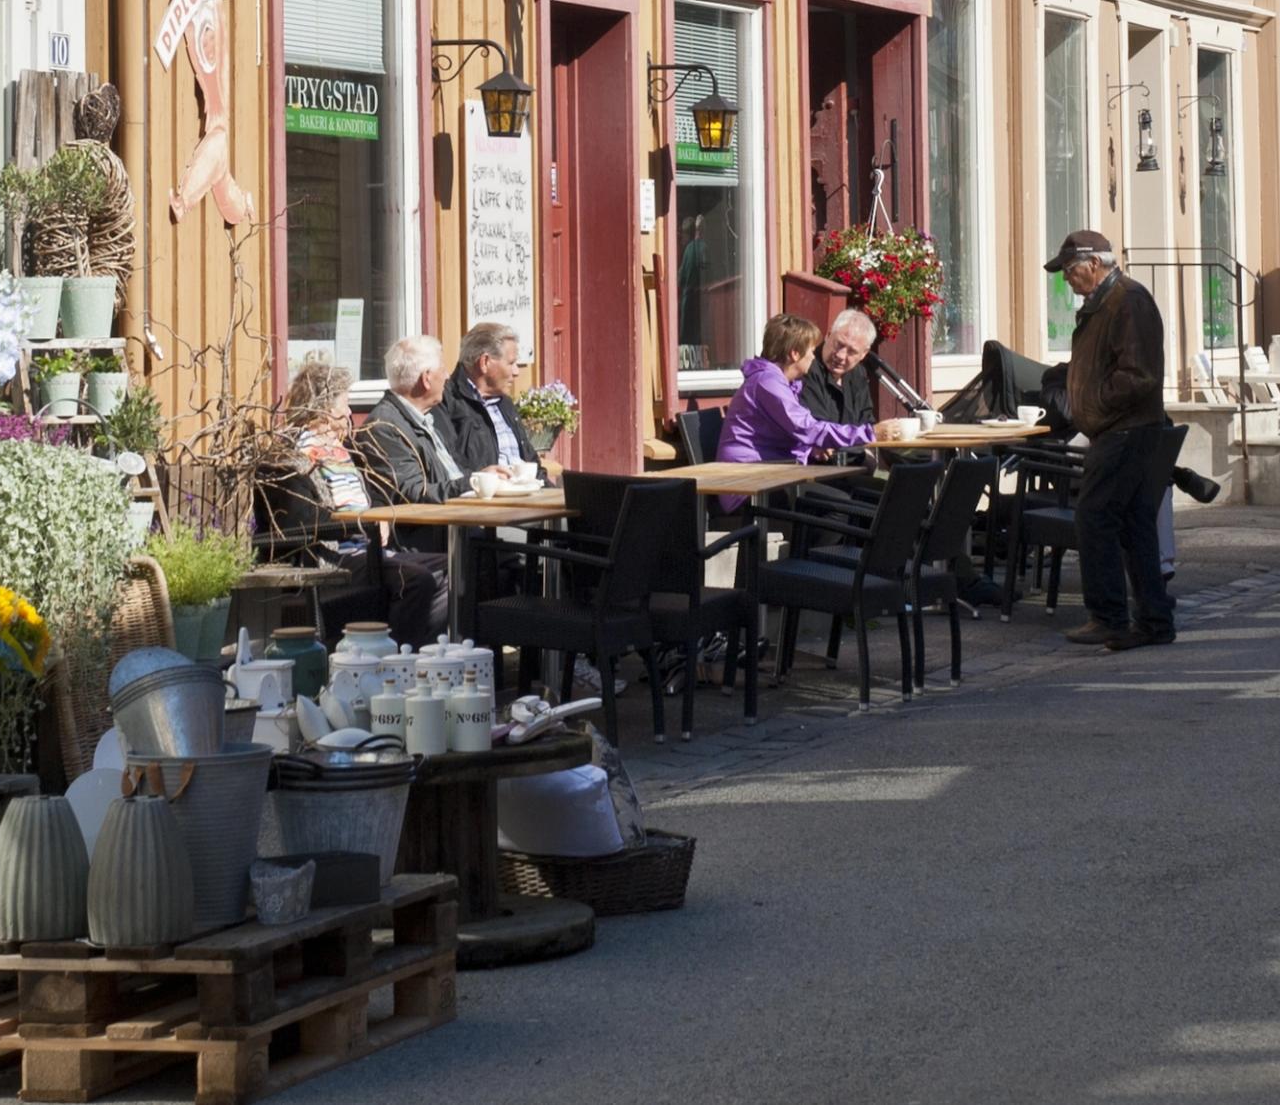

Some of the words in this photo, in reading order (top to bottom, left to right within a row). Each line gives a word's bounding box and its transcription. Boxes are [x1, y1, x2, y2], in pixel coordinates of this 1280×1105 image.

[52, 35, 69, 65] 10
[285, 76, 378, 115] TRYGSTAD
[300, 114, 328, 131] BAKERI
[329, 117, 335, 131] &
[336, 118, 377, 136] KONDITORI
